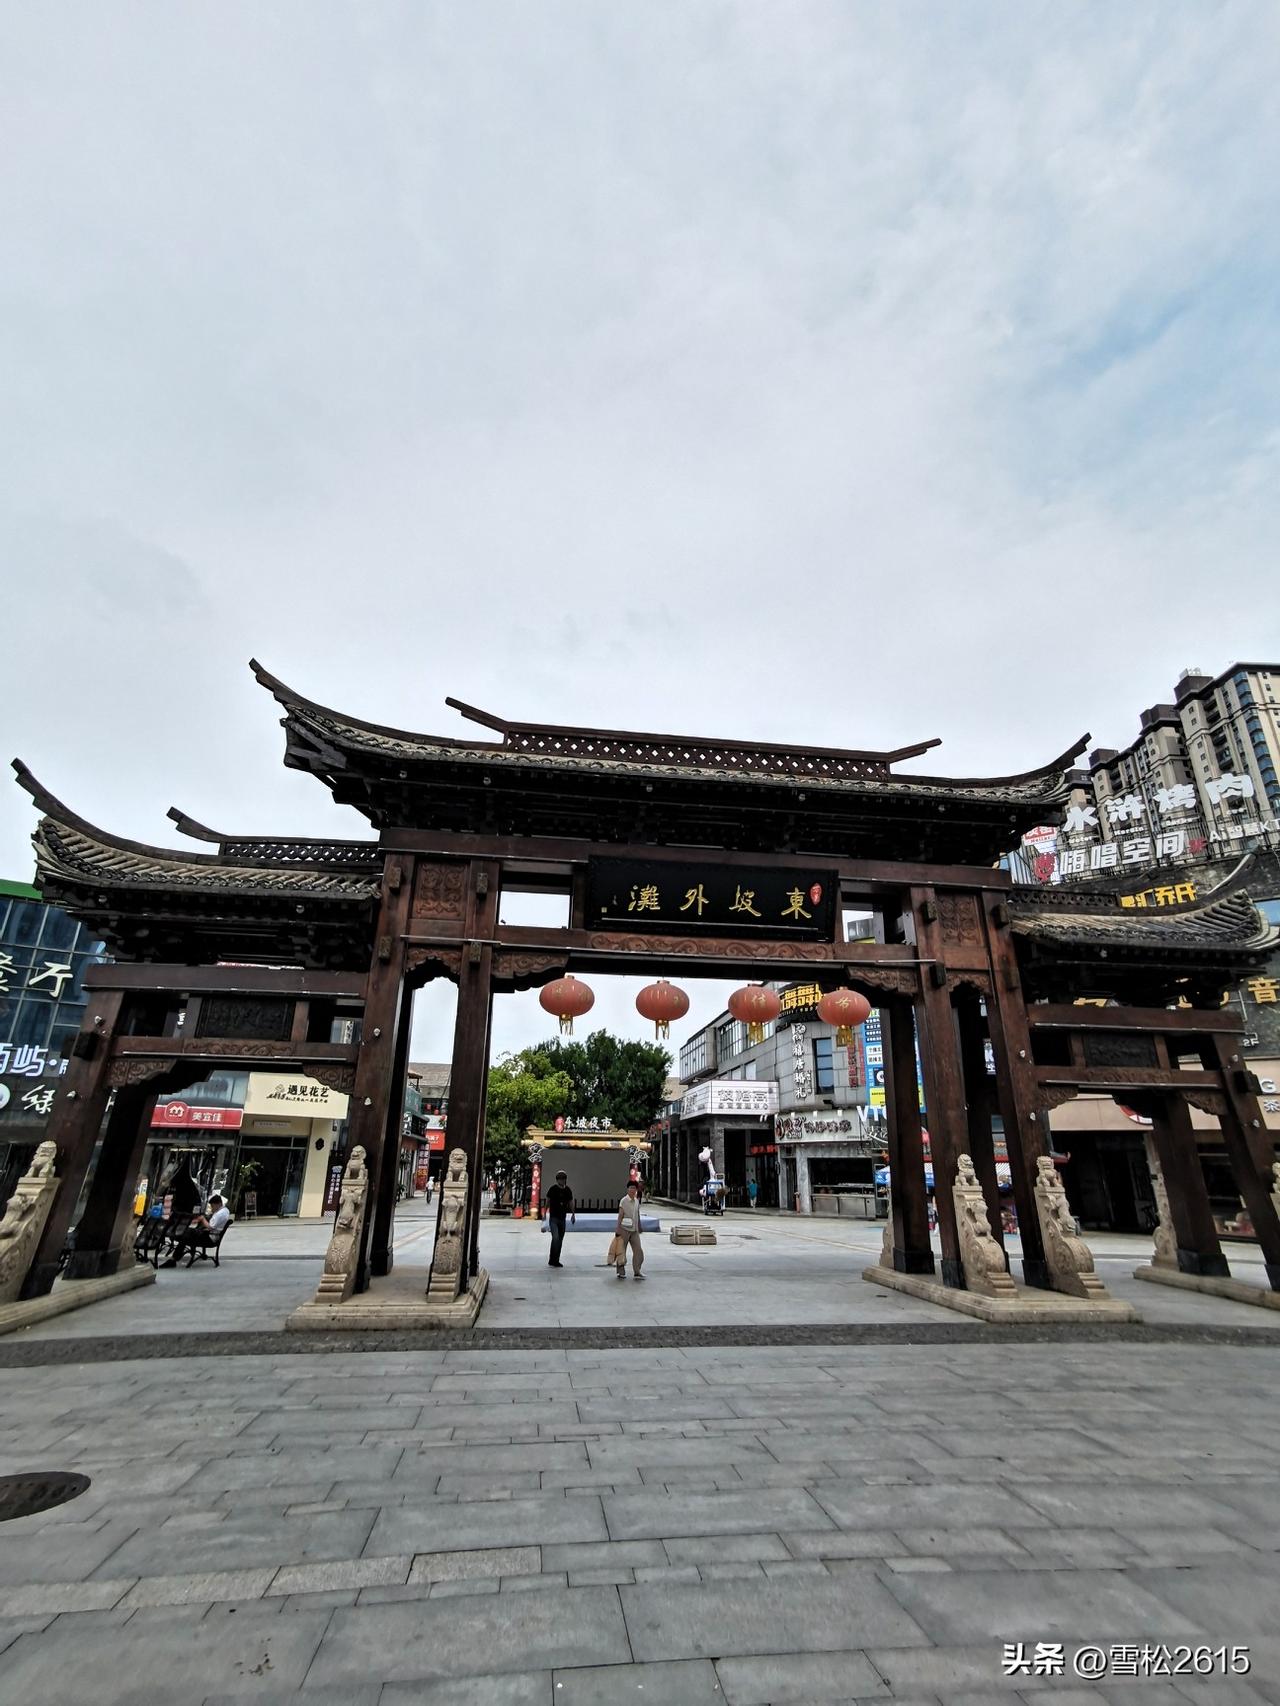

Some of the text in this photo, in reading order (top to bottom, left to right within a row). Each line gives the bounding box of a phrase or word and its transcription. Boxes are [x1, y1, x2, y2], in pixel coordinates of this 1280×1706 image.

[1062, 773, 1254, 831] 水浒烤肉
[1060, 830, 1185, 875] 嗨唱空间
[628, 884, 812, 919] 東坡外灘
[287, 1085, 329, 1098] 遇见花艺
[192, 1111, 221, 1123] 美宜佳
[564, 1116, 612, 1129] 东坡夜市
